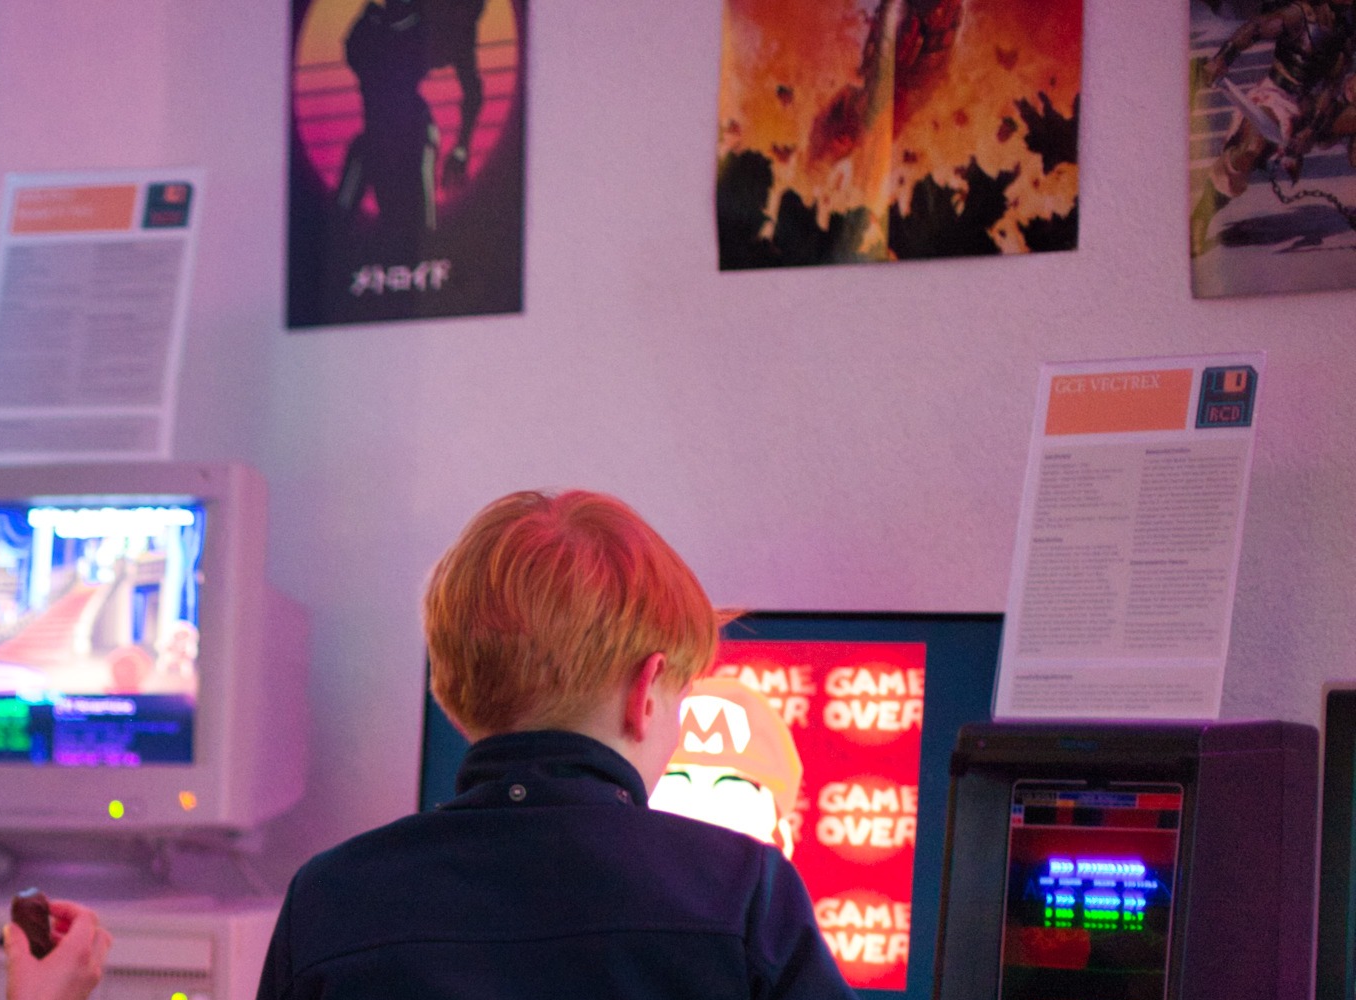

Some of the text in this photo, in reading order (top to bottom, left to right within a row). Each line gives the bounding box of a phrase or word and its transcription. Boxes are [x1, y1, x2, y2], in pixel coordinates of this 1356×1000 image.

[1054, 373, 1161, 393] GCE VECTREX
[1208, 405, 1241, 422] RCD
[825, 667, 926, 697] GAME
[823, 698, 924, 732] OVER
[818, 782, 919, 812] GAME
[816, 815, 917, 848] OVER
[814, 897, 911, 930] GAME
